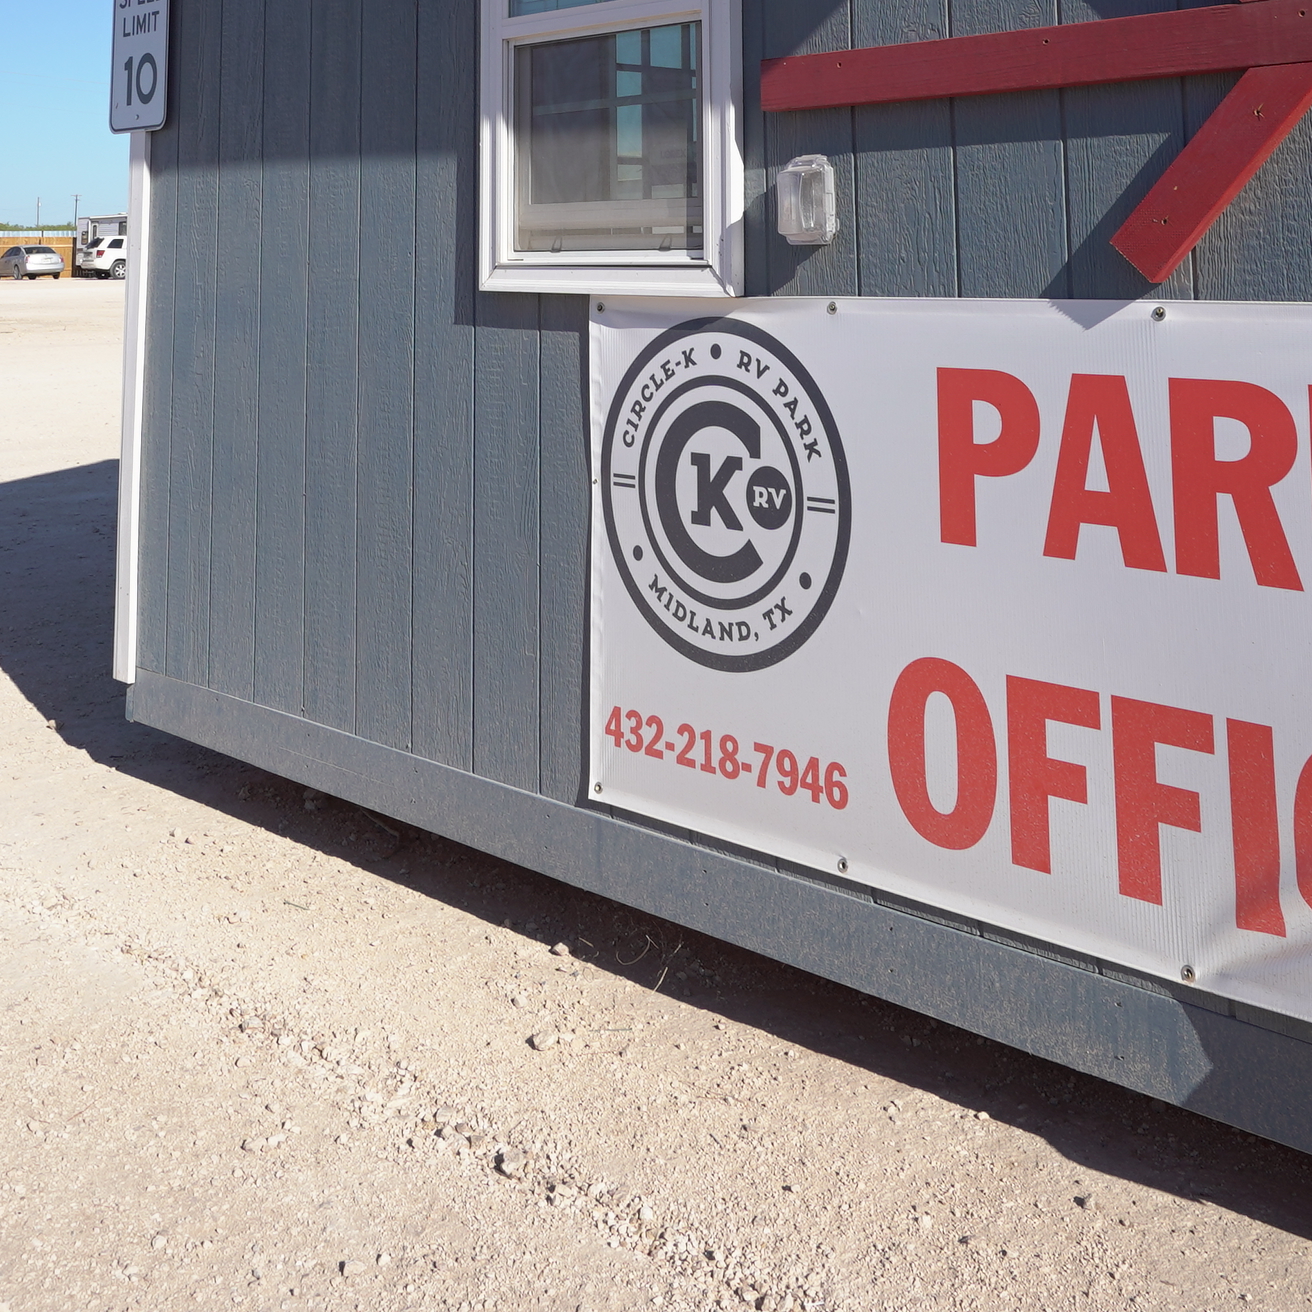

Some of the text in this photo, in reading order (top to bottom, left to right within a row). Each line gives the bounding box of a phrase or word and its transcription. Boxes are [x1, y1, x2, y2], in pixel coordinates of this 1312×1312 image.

[122, 10, 160, 38] LIMIT
[123, 52, 158, 106] 10
[623, 348, 696, 447] CIRCLE-K
[737, 350, 822, 462] RV PARK
[752, 485, 787, 510] RV
[649, 574, 792, 642] MIDLAND, TX
[605, 706, 849, 810] 432-218-7946
